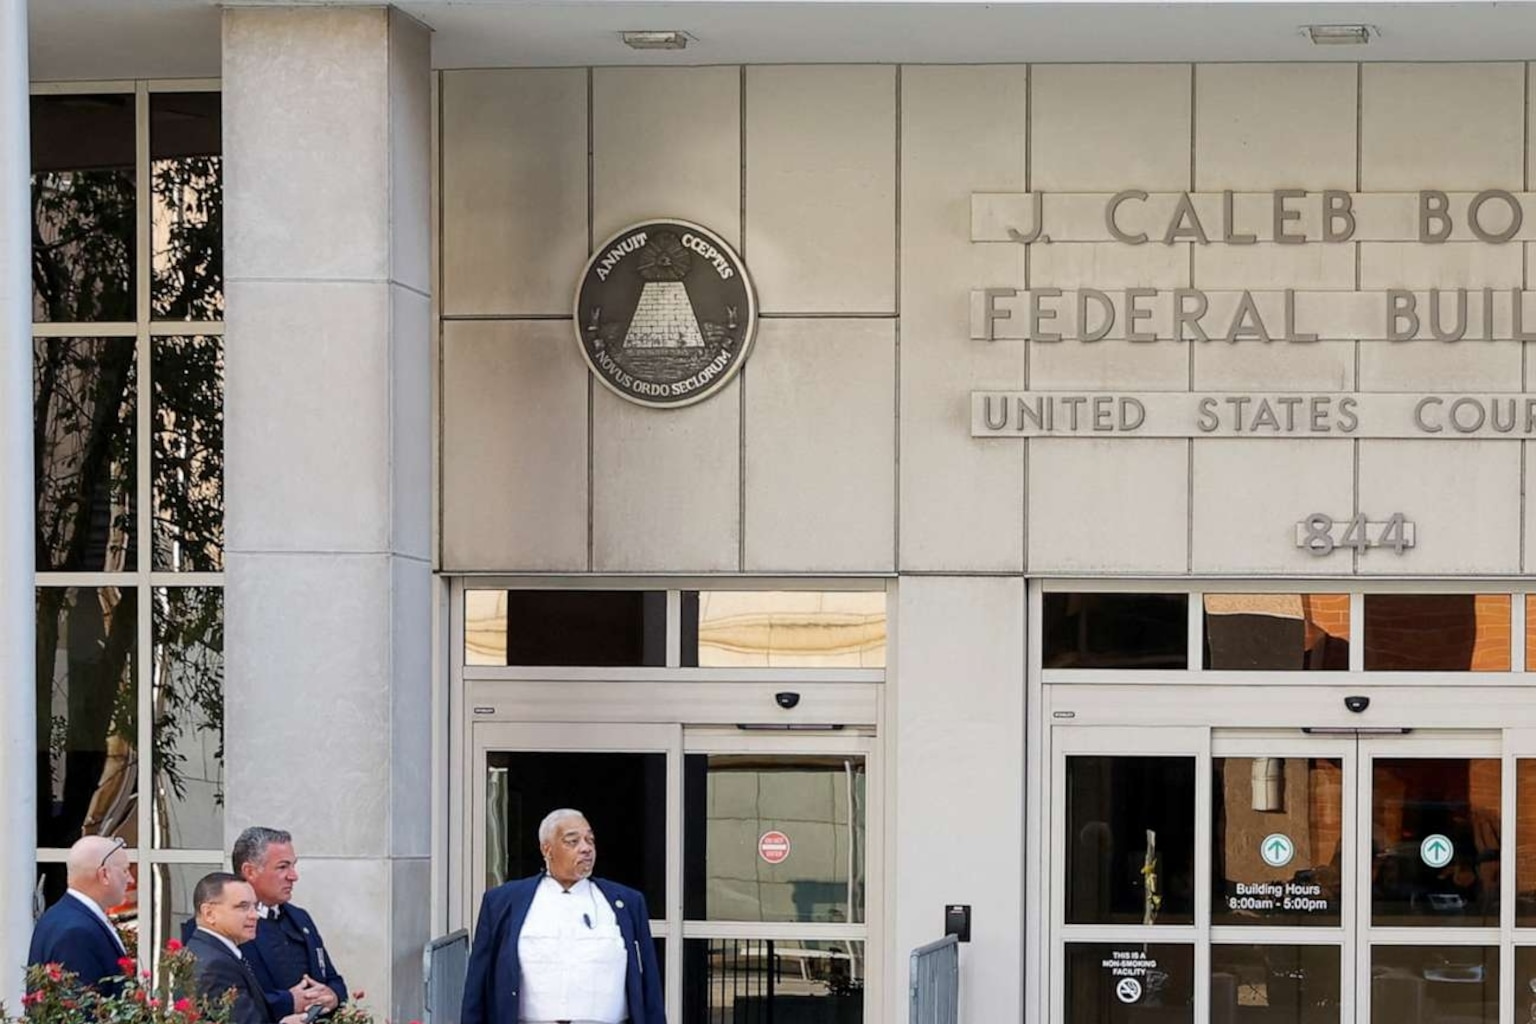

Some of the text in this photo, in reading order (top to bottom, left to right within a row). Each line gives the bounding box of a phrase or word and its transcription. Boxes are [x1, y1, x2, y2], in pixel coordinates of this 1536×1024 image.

[1007, 190, 1050, 245] J.
[1105, 189, 1357, 246] CALEB
[596, 232, 648, 281] ANNUIT
[984, 287, 1319, 343] FEDERAL
[595, 349, 732, 396] NOVUS ORDO SECLORUM
[983, 396, 1146, 432] UNITED
[1197, 396, 1359, 433] STATES
[1303, 512, 1410, 557] 844
[1229, 897, 1273, 909] 8:00am
[1283, 897, 1328, 912] 5:00pm
[1236, 883, 1320, 897] Building Hours
[1102, 960, 1157, 968] NON-SMOKING
[1112, 951, 1147, 959] THIS IS A
[1112, 968, 1146, 976] FACILITY
